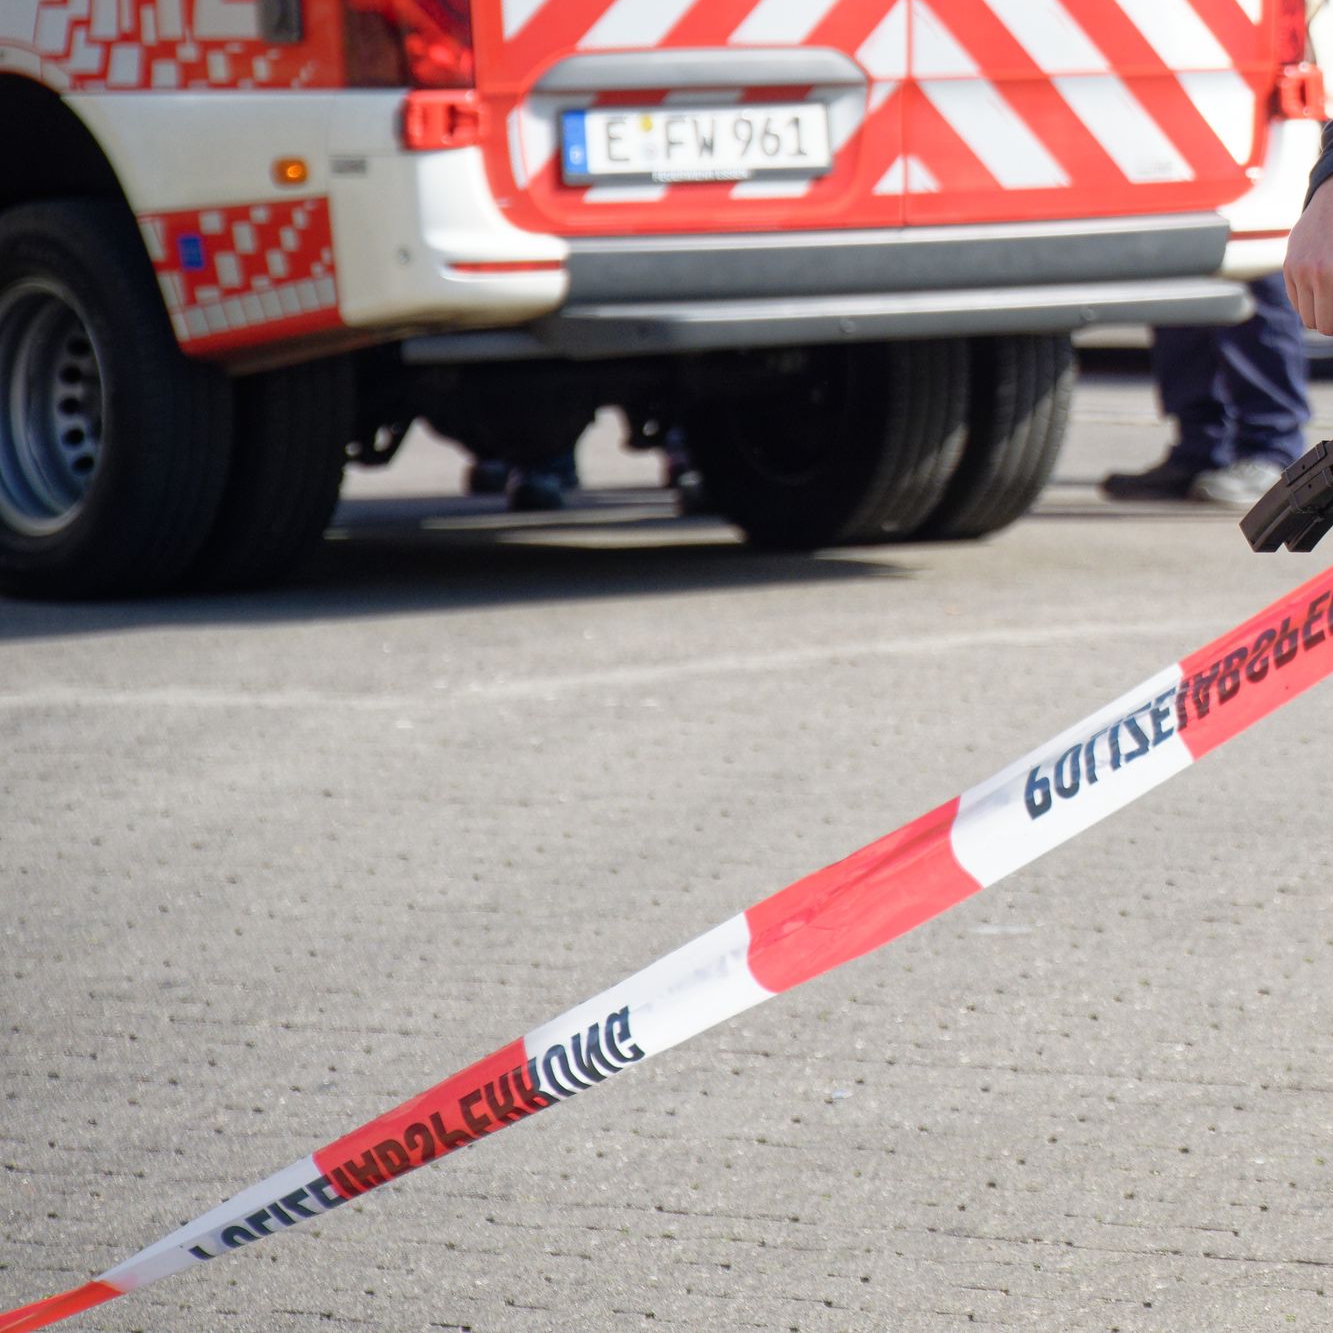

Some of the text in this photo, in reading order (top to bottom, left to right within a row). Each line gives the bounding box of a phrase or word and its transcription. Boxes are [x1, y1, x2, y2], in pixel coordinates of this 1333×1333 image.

[605, 116, 808, 162] E FW 961
